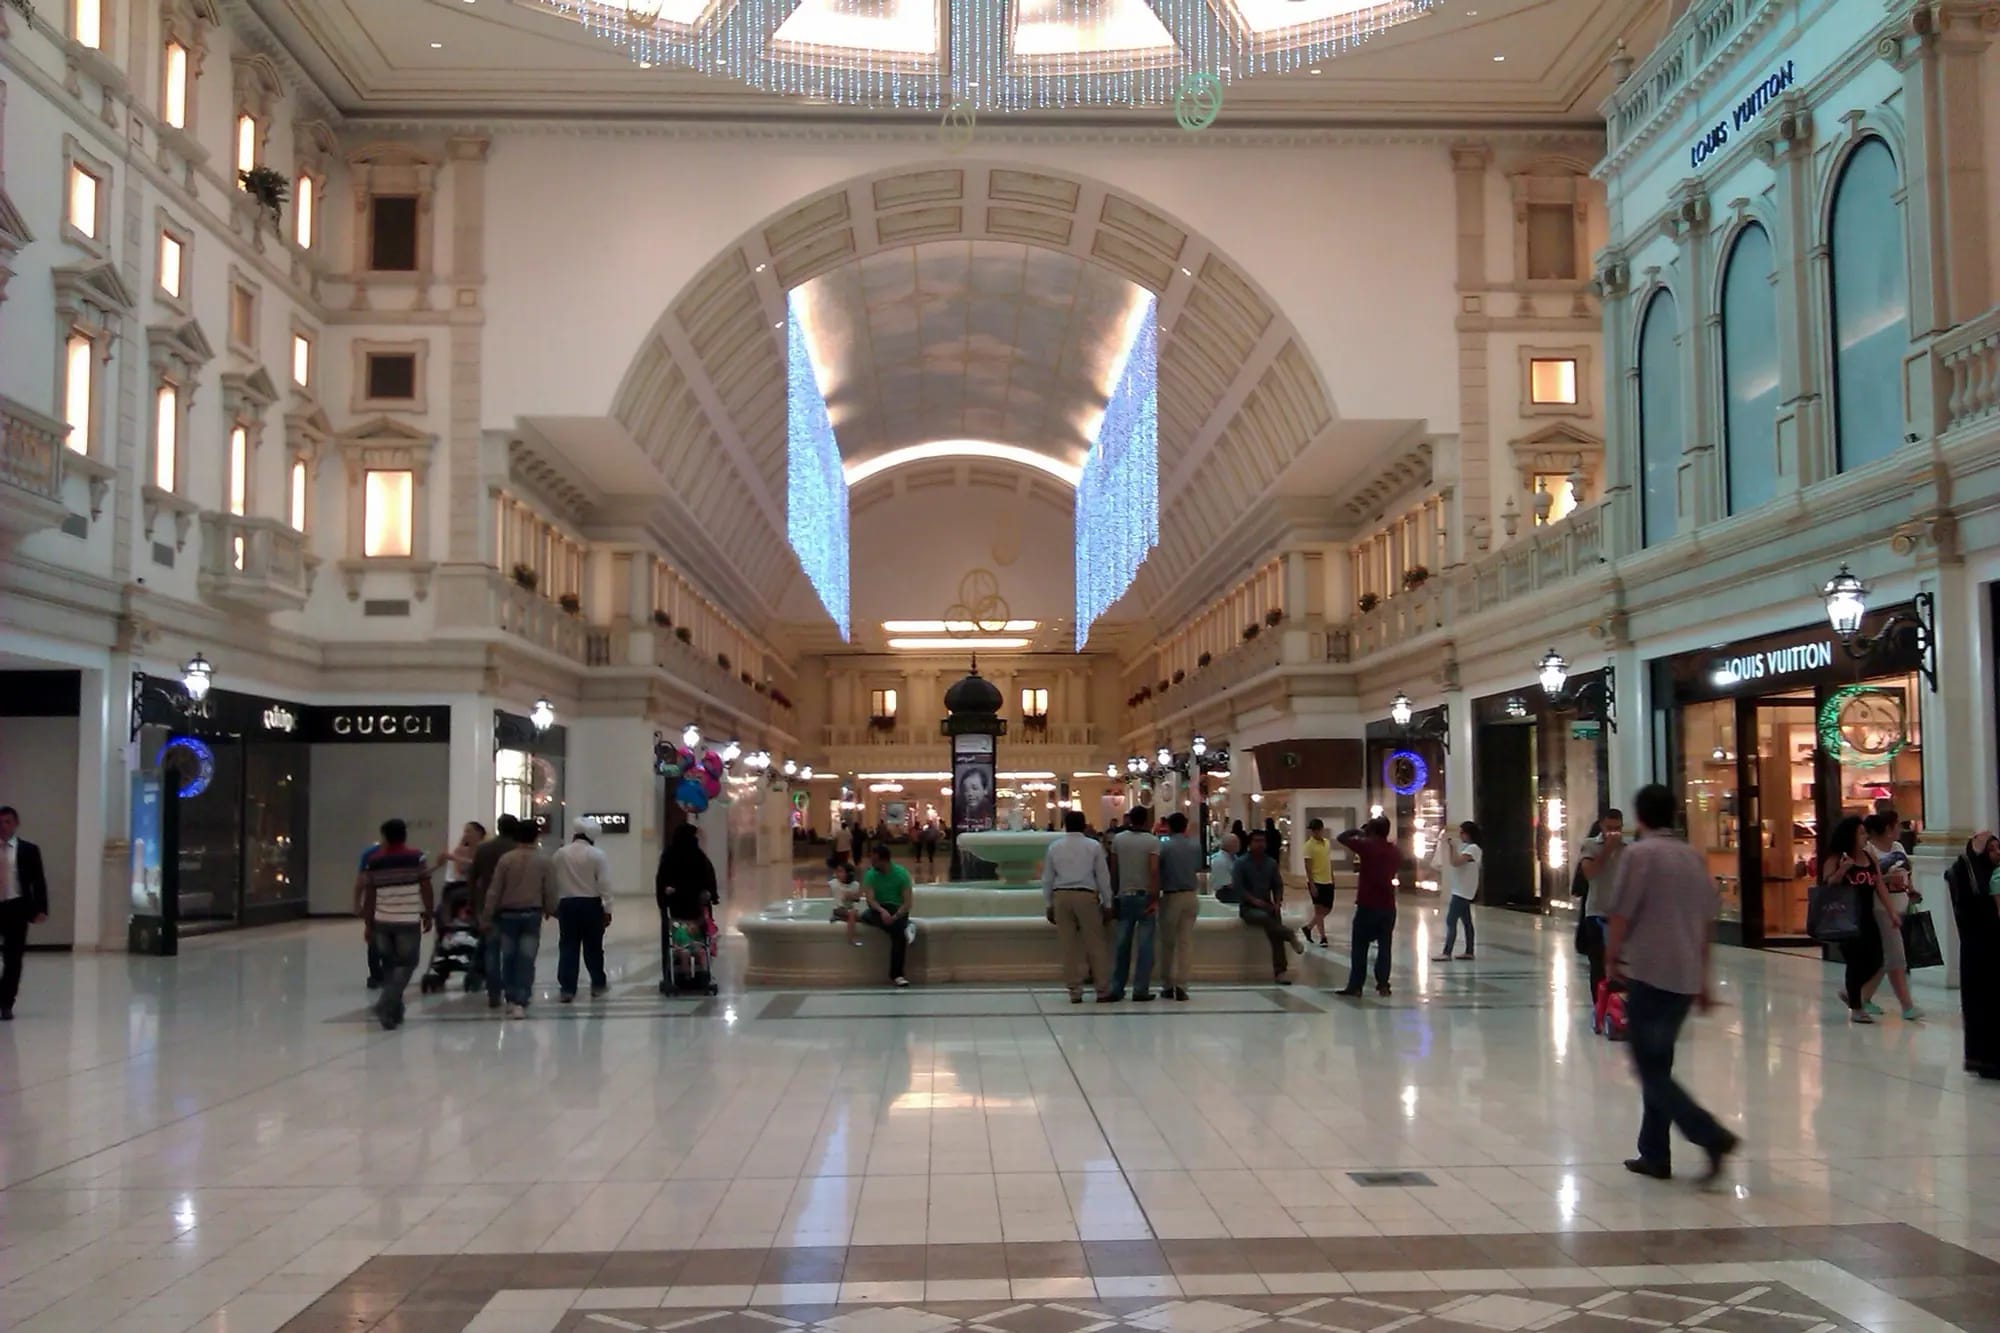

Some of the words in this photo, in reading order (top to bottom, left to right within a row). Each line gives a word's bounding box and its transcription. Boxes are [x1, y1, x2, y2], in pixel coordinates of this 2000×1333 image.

[1691, 121, 1727, 168] LOUIS
[1733, 60, 1793, 131] VUITTON
[1766, 641, 1831, 675] VUITTON
[334, 714, 432, 734] GUCCI
